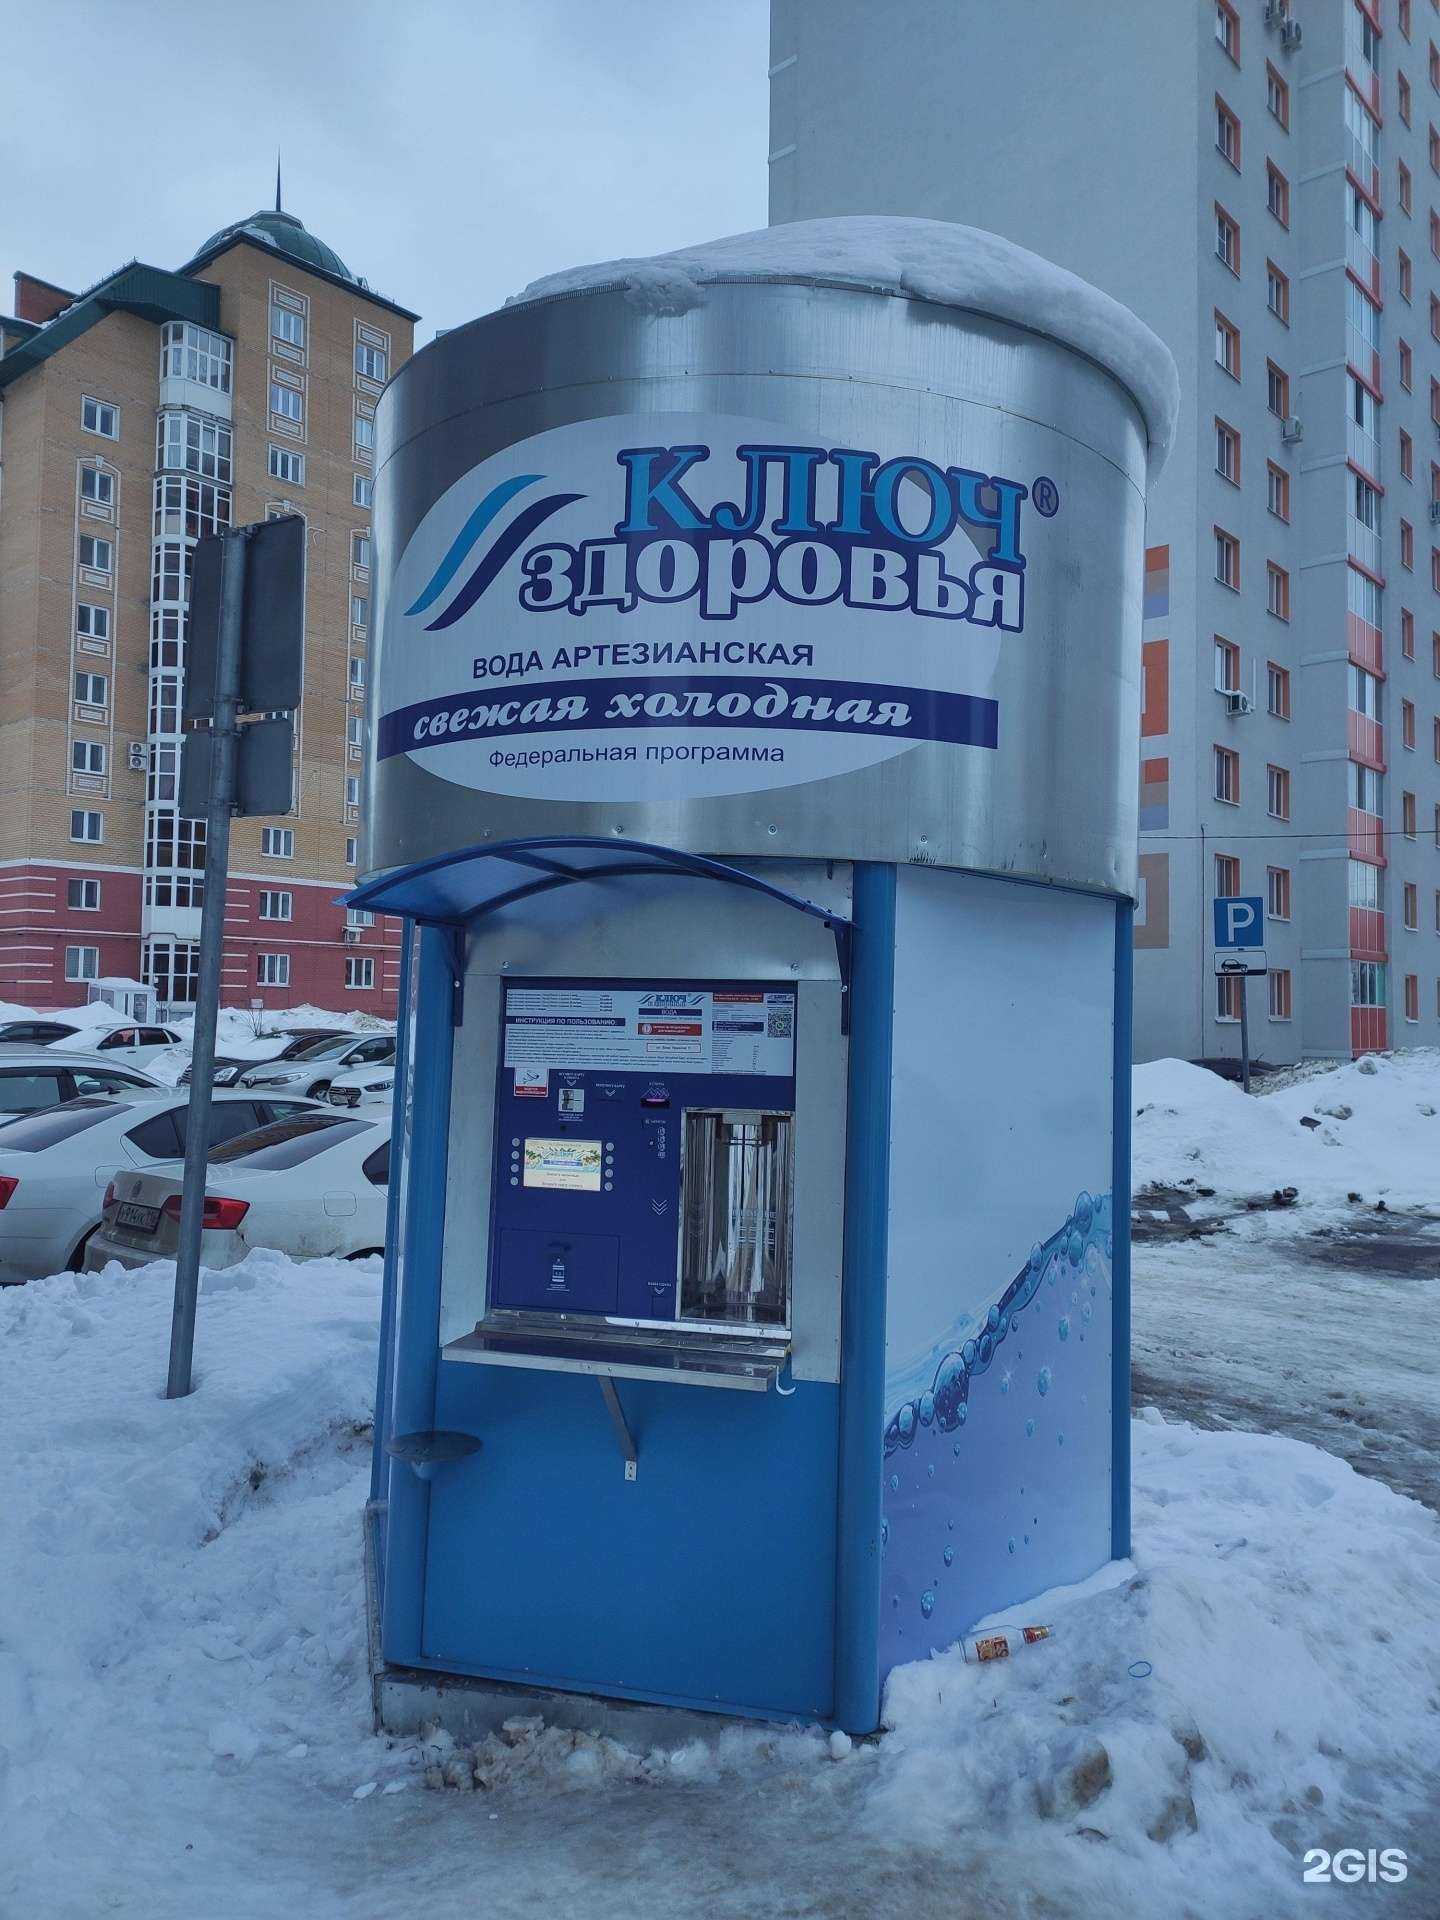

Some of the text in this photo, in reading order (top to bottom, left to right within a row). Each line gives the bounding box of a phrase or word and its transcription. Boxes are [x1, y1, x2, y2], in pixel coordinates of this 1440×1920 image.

[617, 444, 1029, 563] КЛЮЧ
[518, 534, 1024, 632] здоровья
[472, 641, 814, 679] ВОДА АРТЕЗИАНСКАЯ
[412, 682, 913, 741] свежая холодная
[489, 743, 785, 769] Федеральная программа
